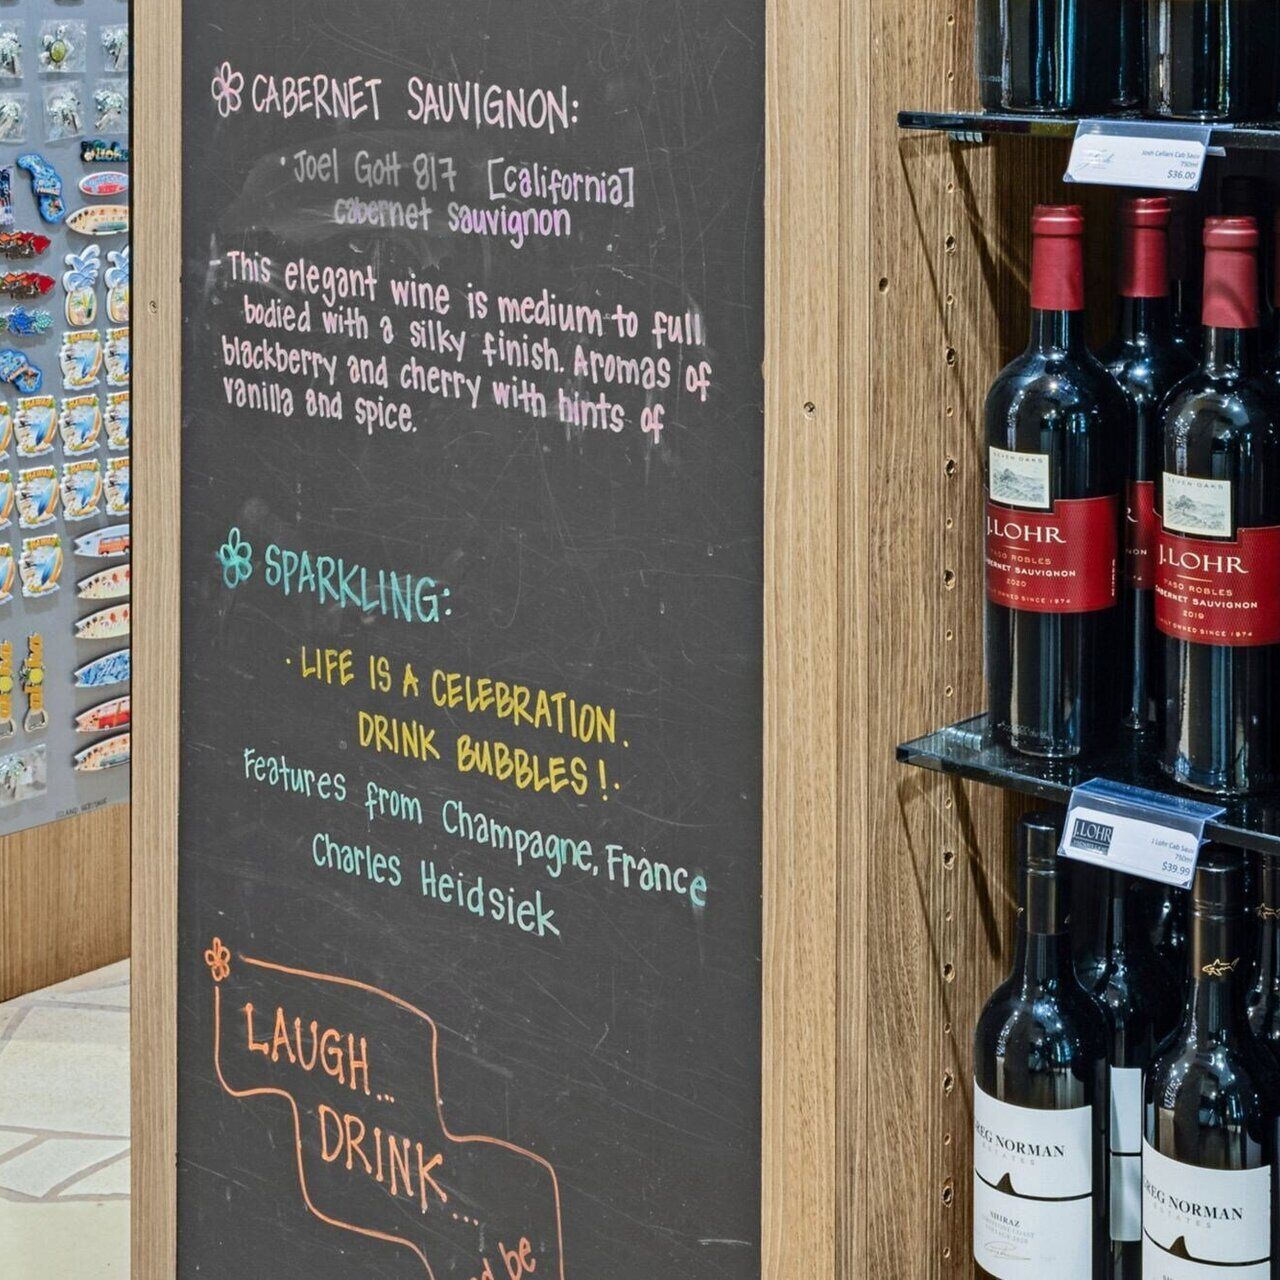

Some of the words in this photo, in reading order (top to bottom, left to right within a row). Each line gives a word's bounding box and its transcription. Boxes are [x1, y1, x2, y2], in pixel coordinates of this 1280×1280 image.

[251, 74, 382, 121] CABERNET
[407, 76, 579, 134] SAUVIGNON:
[293, 148, 339, 184] Joel
[354, 150, 402, 187] Gott
[1168, 170, 1196, 179] $36.00
[334, 197, 433, 232] cabernet
[447, 201, 571, 250] sauvignon
[227, 251, 271, 282] This
[285, 258, 377, 307] elegant
[391, 273, 450, 314] wine
[467, 282, 488, 320] is
[497, 288, 603, 337] medium
[612, 304, 638, 338] to
[652, 311, 702, 349] full
[244, 294, 311, 332] bodied
[322, 305, 368, 339] with
[379, 315, 394, 344] a
[409, 320, 466, 362] silky
[482, 330, 564, 372] finish.
[574, 344, 671, 389] Aromas
[685, 361, 712, 402] of
[221, 335, 338, 385] blackberry
[347, 355, 388, 388] and
[400, 356, 482, 409] cherry
[493, 376, 547, 417] with
[558, 388, 625, 432] hints
[640, 403, 665, 444] of
[223, 376, 294, 417] vanilla
[306, 388, 342, 420] and
[355, 395, 418, 435] spice.
[264, 545, 452, 622] SPARKLING:
[1159, 545, 1249, 574] J.LOHR
[300, 646, 354, 685] LIFE
[370, 655, 392, 692] IS
[403, 664, 419, 696] A
[358, 711, 440, 761] DRINK
[243, 748, 347, 801] Features
[365, 781, 422, 824] from
[442, 799, 599, 877] Champagne,
[605, 843, 708, 907] France
[1073, 820, 1112, 842] J.LOHR
[312, 832, 402, 886] Charles
[421, 859, 560, 937] Heidsiek
[1162, 861, 1190, 875] $39.99
[996, 1137, 1066, 1158] NORMAN
[1168, 1199, 1244, 1221] NORMAN
